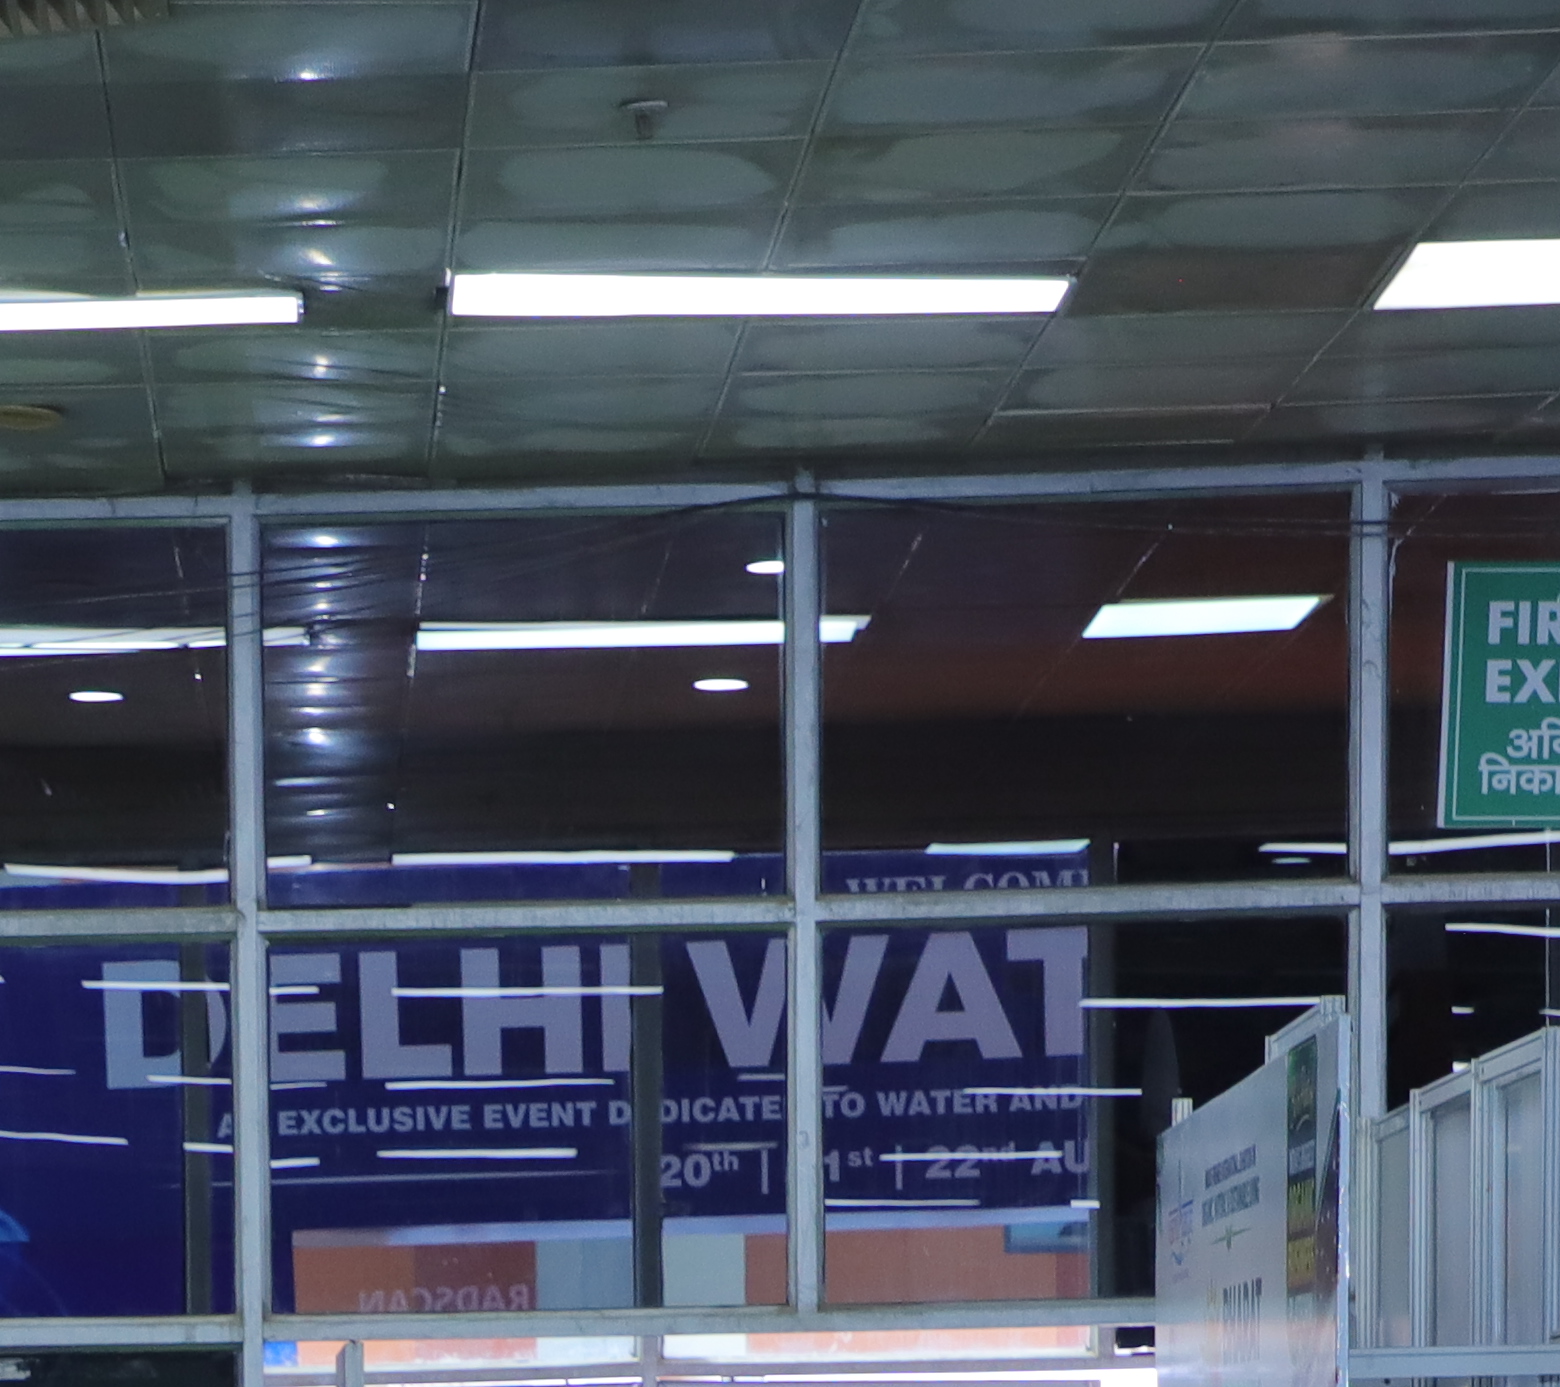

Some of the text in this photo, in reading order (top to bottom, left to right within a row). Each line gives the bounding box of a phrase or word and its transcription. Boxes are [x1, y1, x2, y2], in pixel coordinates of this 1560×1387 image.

[102, 944, 630, 1089] DELHI
[279, 1086, 1088, 1136] EXCLUSIVE EVENT DDICATE TO WATER AND
[660, 1150, 739, 1188] 20th
[824, 1147, 873, 1182] 1st
